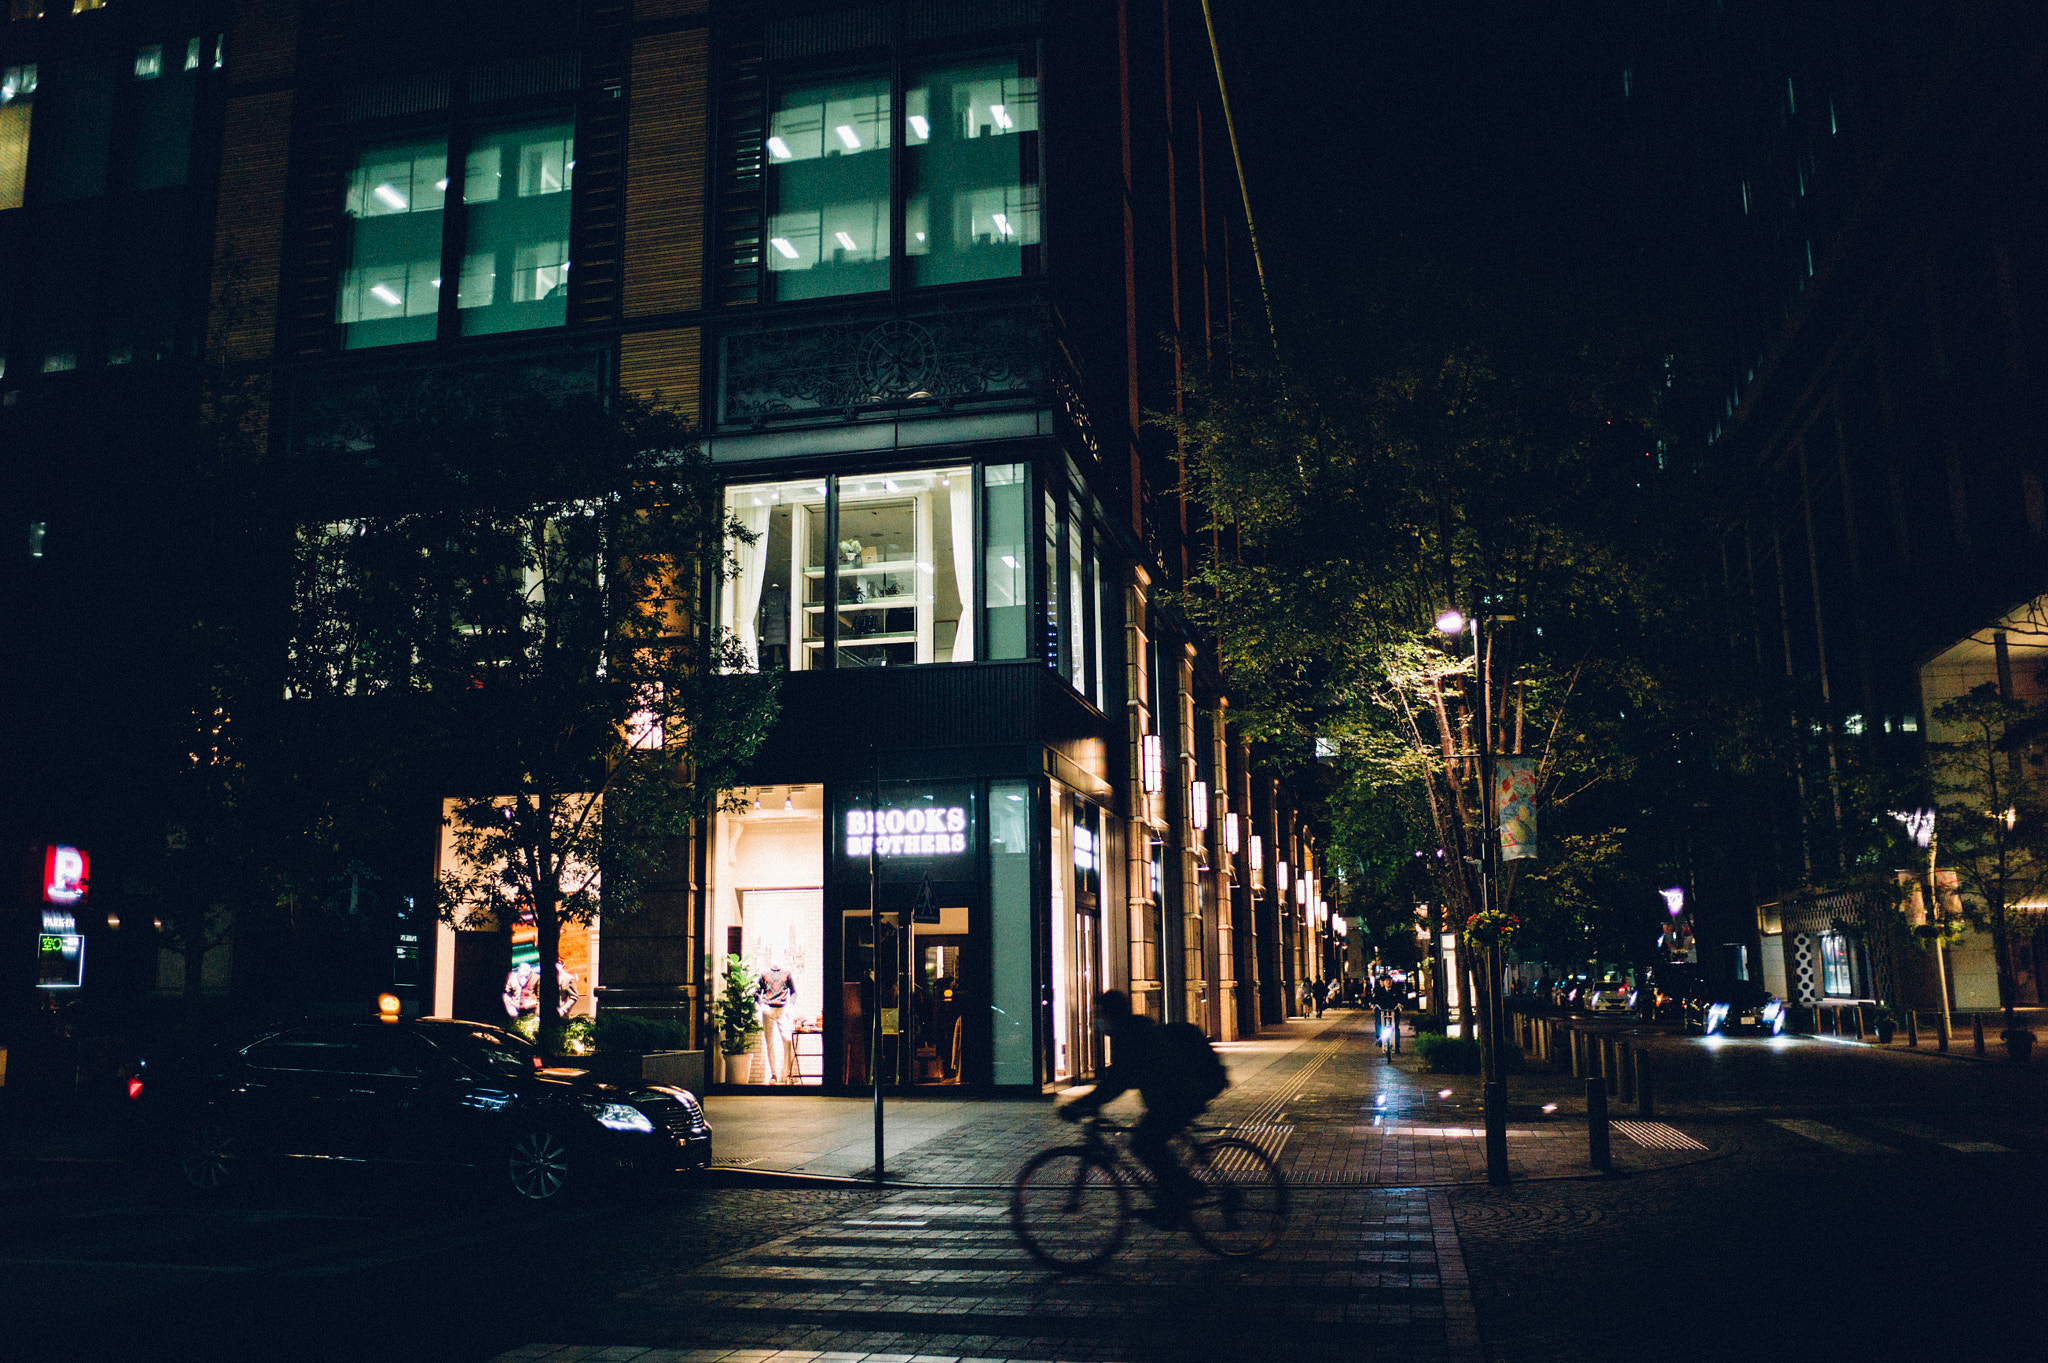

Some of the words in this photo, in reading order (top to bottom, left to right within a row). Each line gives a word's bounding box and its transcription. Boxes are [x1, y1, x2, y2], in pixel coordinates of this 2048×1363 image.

[847, 808, 965, 835] BROOKS
[847, 833, 966, 855] BROTHERS
[43, 917, 75, 927] PARK-IN
